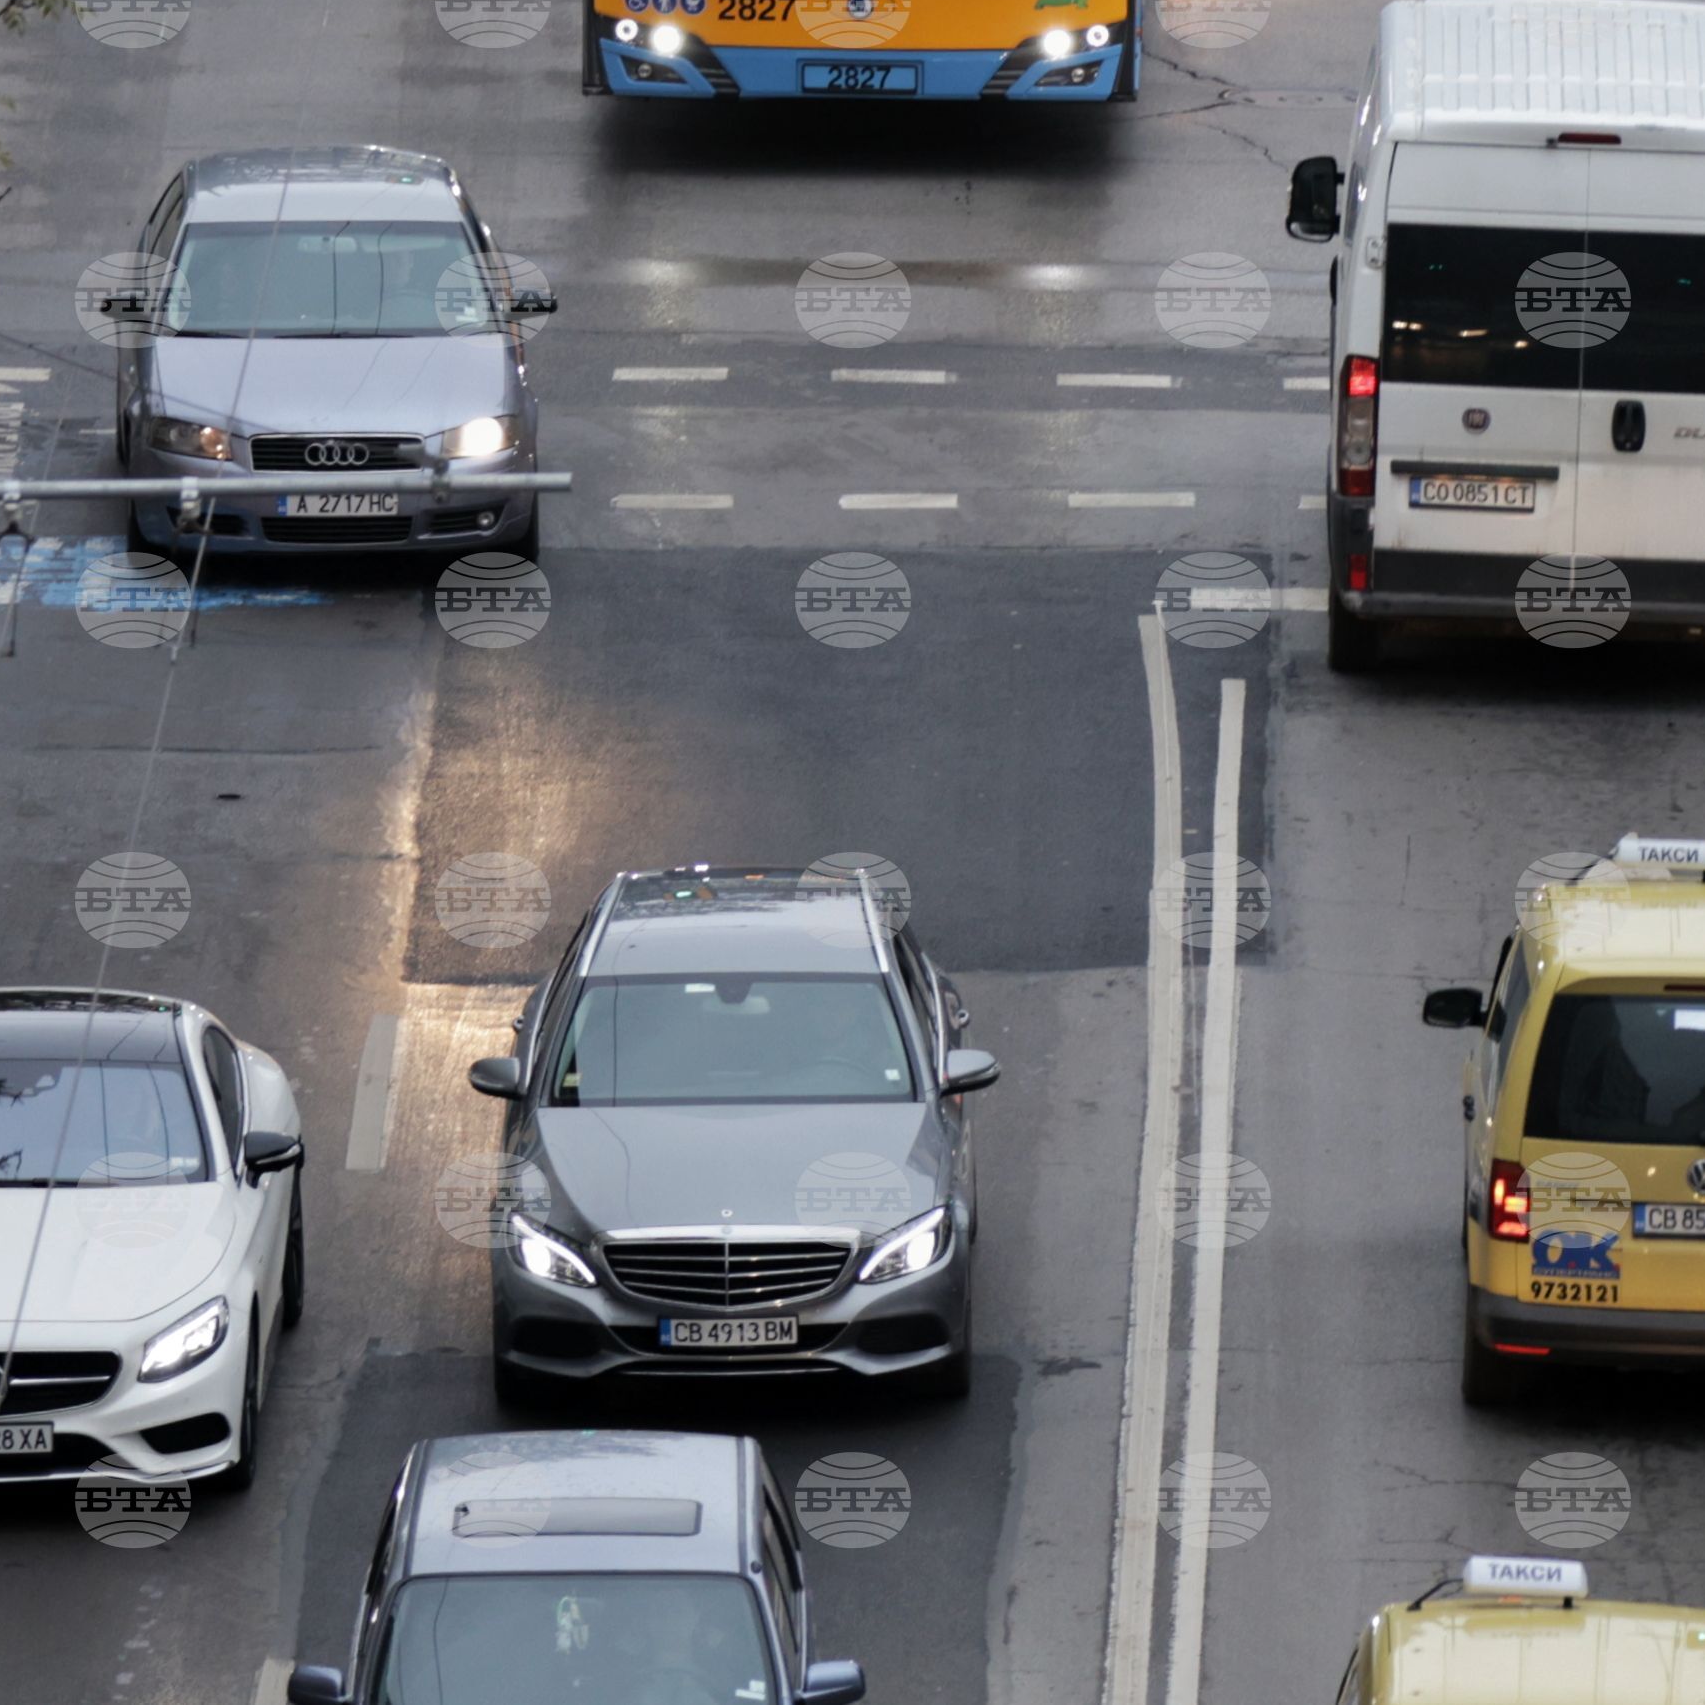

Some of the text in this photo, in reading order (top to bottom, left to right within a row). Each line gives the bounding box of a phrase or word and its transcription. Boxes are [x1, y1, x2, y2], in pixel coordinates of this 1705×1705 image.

[828, 65, 892, 90] 2827
[1639, 846, 1700, 863] ТАКСИ
[1648, 1207, 1677, 1230] CB
[1531, 1280, 1619, 1303] 9732121
[674, 1320, 794, 1343] CB 4913 BM
[18, 1427, 48, 1450] XA
[1489, 1562, 1563, 1582] ТАКСИ
